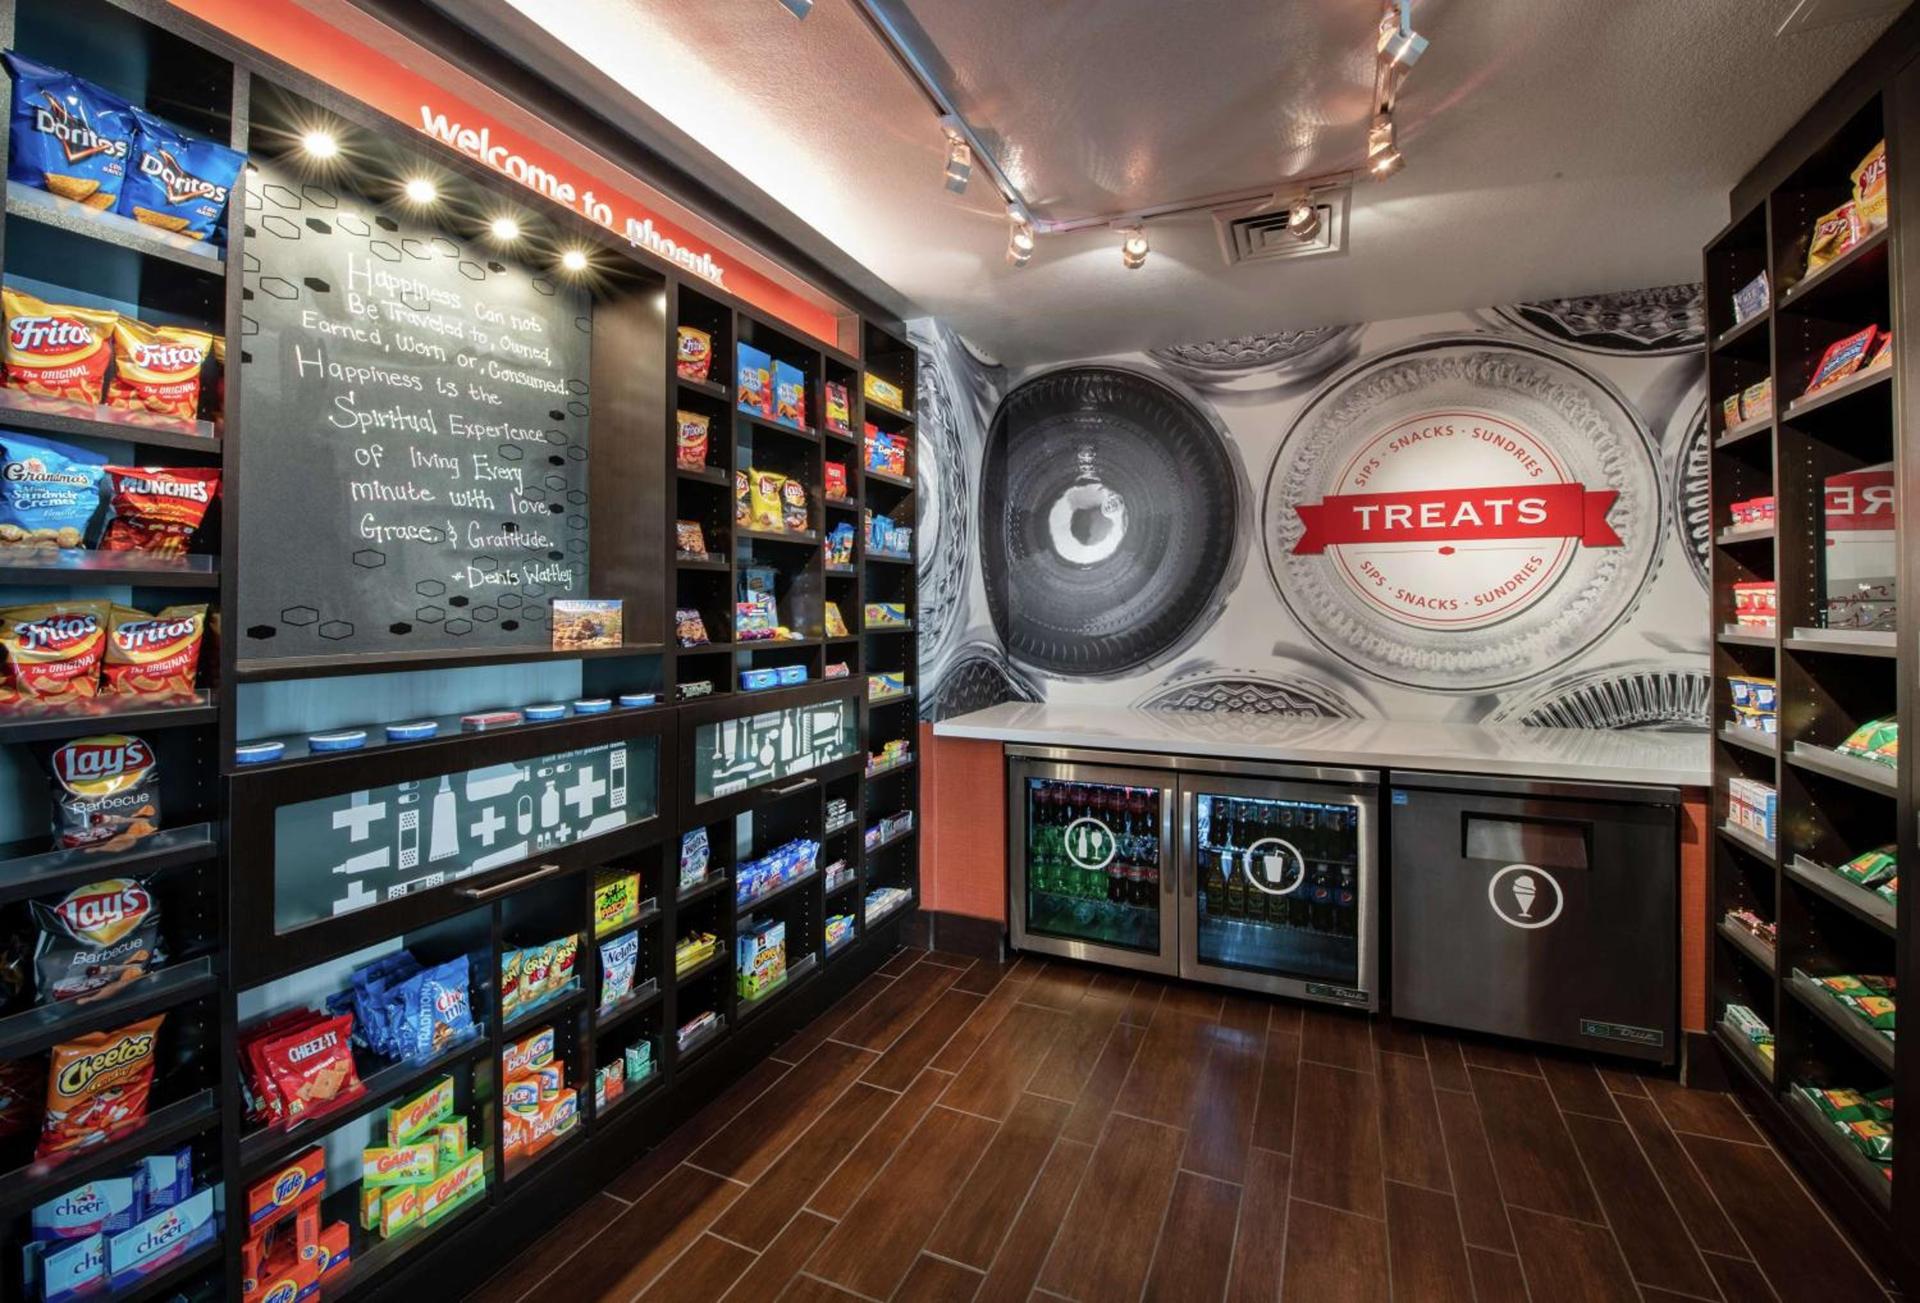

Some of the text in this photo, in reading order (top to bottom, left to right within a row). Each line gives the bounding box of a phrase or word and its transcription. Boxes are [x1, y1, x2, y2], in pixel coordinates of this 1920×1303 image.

[36, 109, 128, 158] Doritos
[140, 152, 229, 203] Doritos
[420, 104, 723, 287] Welcome to phoenix
[348, 252, 542, 333] Happiness Can not
[348, 292, 379, 320] Be
[381, 300, 464, 338] Traveled
[10, 316, 93, 350] Fritos
[302, 310, 390, 352] Earned,
[396, 334, 446, 362] Worn
[41, 365, 90, 380] ORIGINAL
[133, 344, 203, 367] Fritos
[159, 383, 196, 395] ORIGINAL
[295, 345, 502, 405] Happiness is the
[329, 391, 547, 444] Spiritual Experience
[410, 447, 460, 480] living
[473, 454, 523, 495] Every
[1355, 424, 1543, 487] SIPS SNACKS SUNDRIES
[3, 462, 88, 485] Grandma's
[120, 477, 208, 503] MUNCHIES
[12, 490, 77, 500] Sandwich
[351, 480, 551, 515] minute with love,
[1353, 498, 1548, 530] TREATS
[468, 520, 554, 549] Gratitude.
[467, 566, 520, 588] Denis
[1360, 555, 1543, 611] SIPS SNACKS SUNDRIES
[15, 616, 97, 650] Fritos
[118, 617, 194, 650] Fritos
[49, 653, 95, 673] ORIGINAL
[147, 655, 190, 673] ORIGINAL
[72, 792, 150, 815] Barbecue
[72, 938, 143, 965] Barbecue
[60, 1036, 151, 1094] Cheetos
[56, 1200, 103, 1217] cheer
[138, 1220, 186, 1254] cheer
